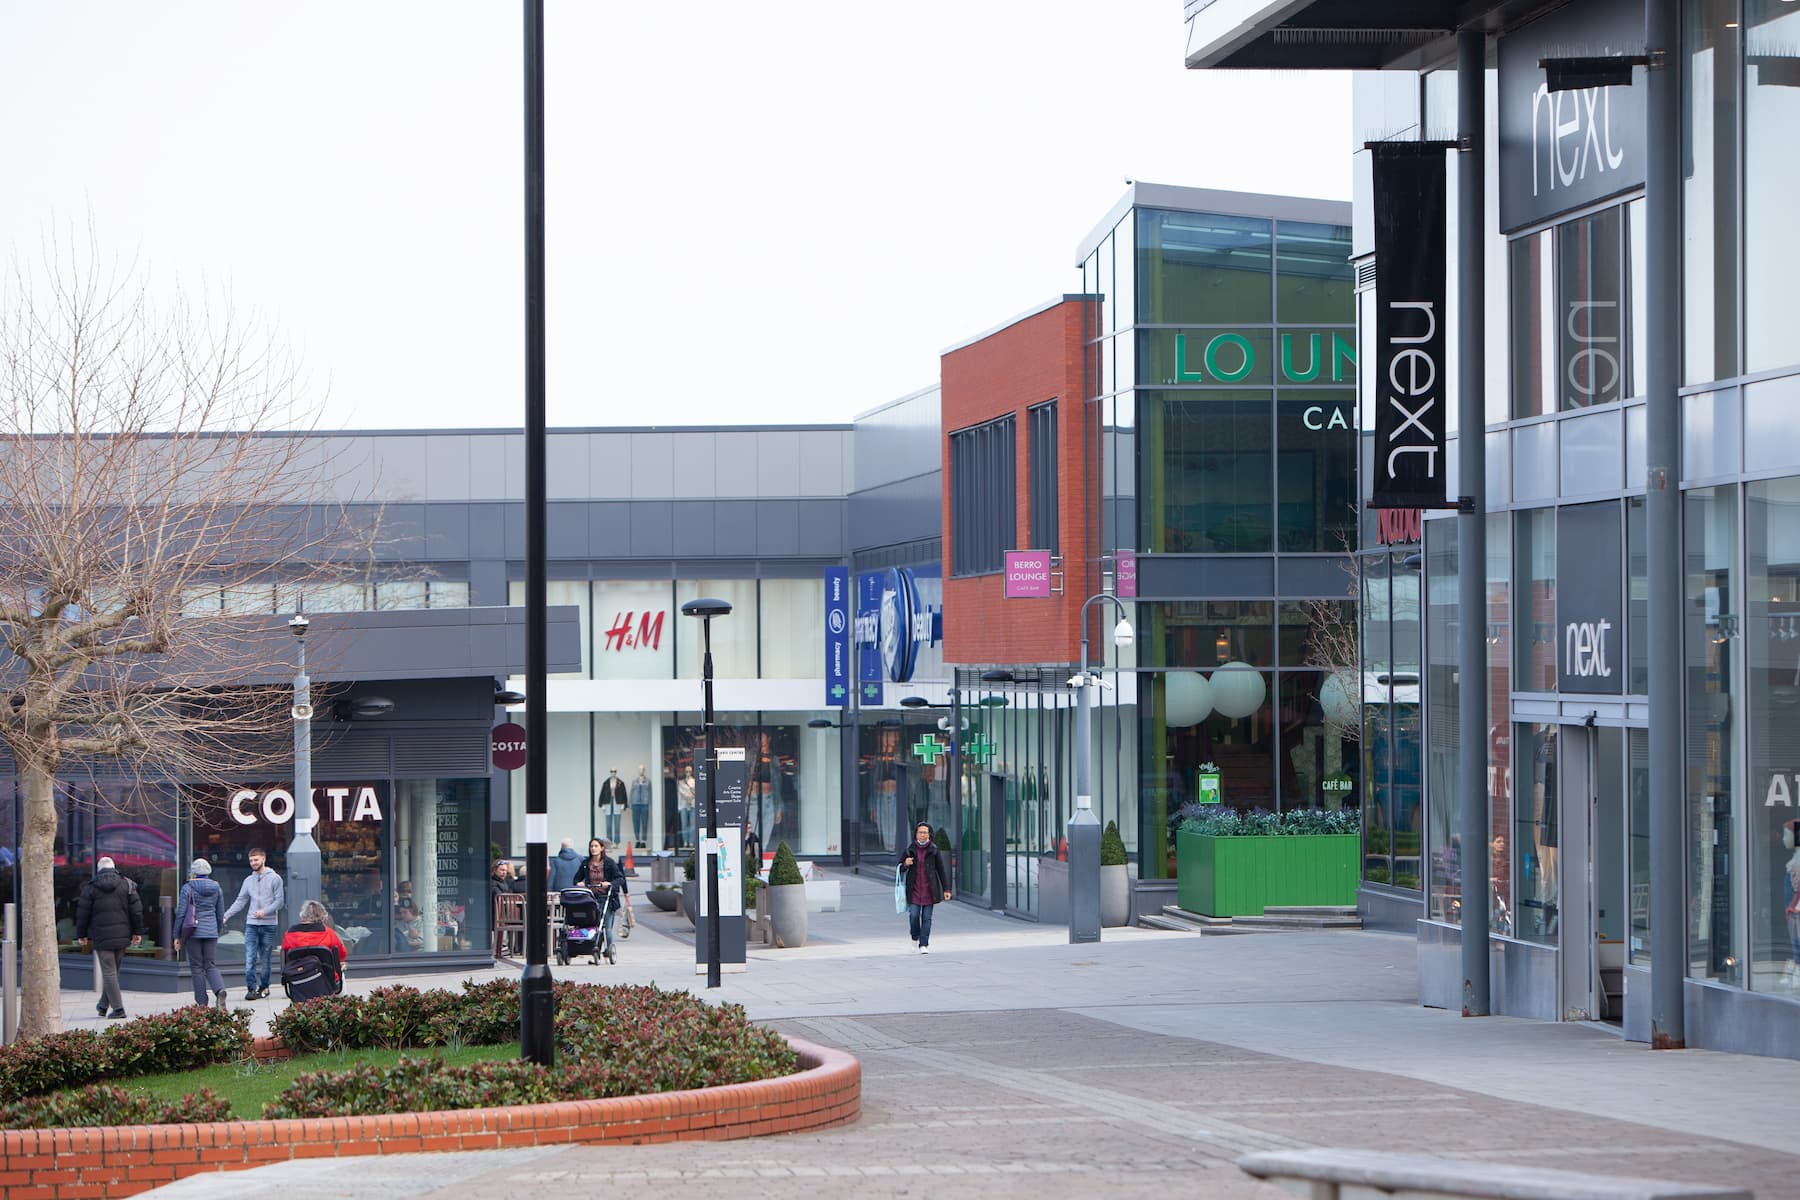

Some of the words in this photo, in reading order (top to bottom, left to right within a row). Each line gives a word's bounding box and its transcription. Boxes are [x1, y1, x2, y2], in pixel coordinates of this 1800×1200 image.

[1533, 80, 1623, 196] next
[1388, 302, 1438, 479] next
[1009, 573, 1047, 581] LOUNGE
[1014, 561, 1042, 569] BERRO
[833, 577, 841, 601] beauty
[604, 611, 664, 652] H&M
[834, 642, 842, 676] pharmacy
[1566, 618, 1611, 677] next
[492, 742, 526, 752] COSTA
[1322, 779, 1339, 791] CAFÉ
[1340, 780, 1353, 791] BAR
[440, 831, 458, 841] COLD
